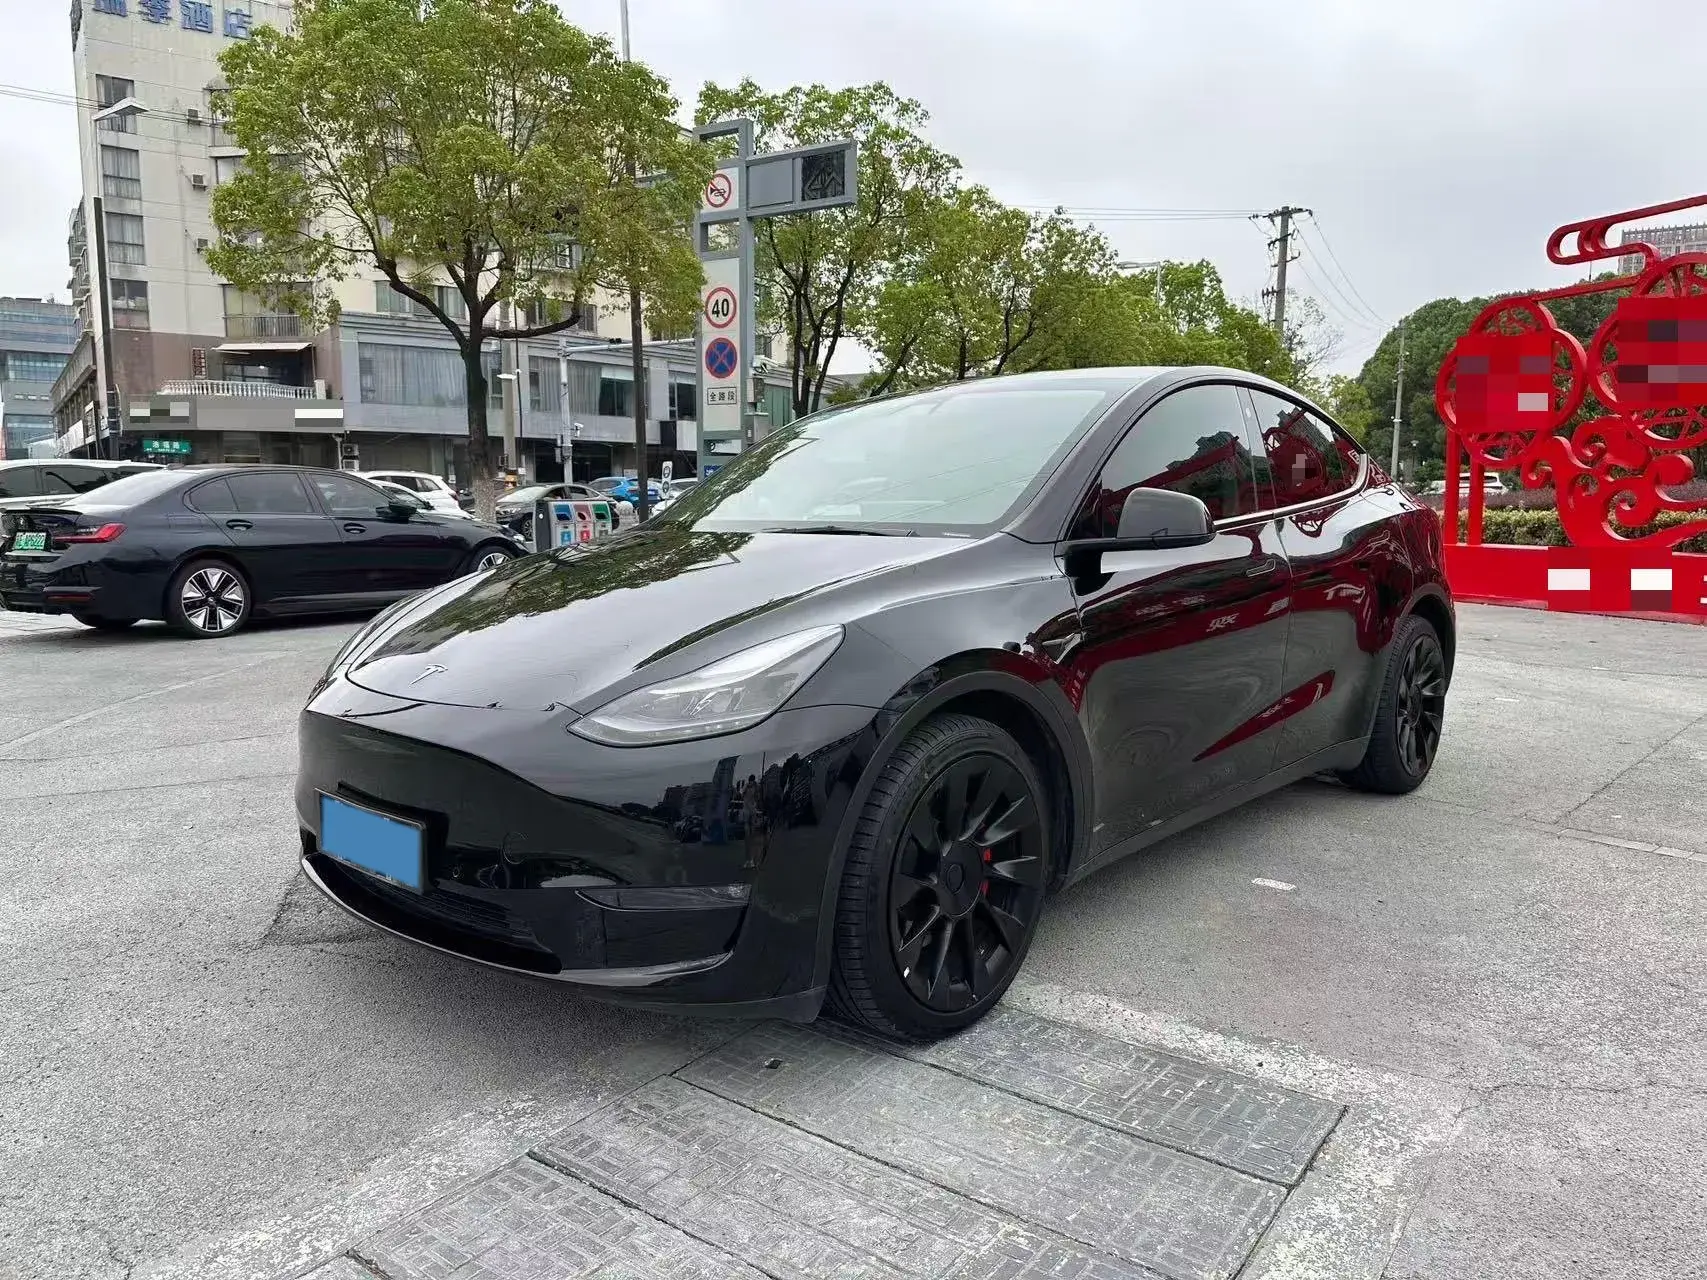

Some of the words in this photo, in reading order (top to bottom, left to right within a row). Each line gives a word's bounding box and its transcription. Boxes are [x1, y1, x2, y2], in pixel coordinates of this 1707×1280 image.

[712, 298, 730, 318] 40
[709, 390, 735, 402] 全路段
